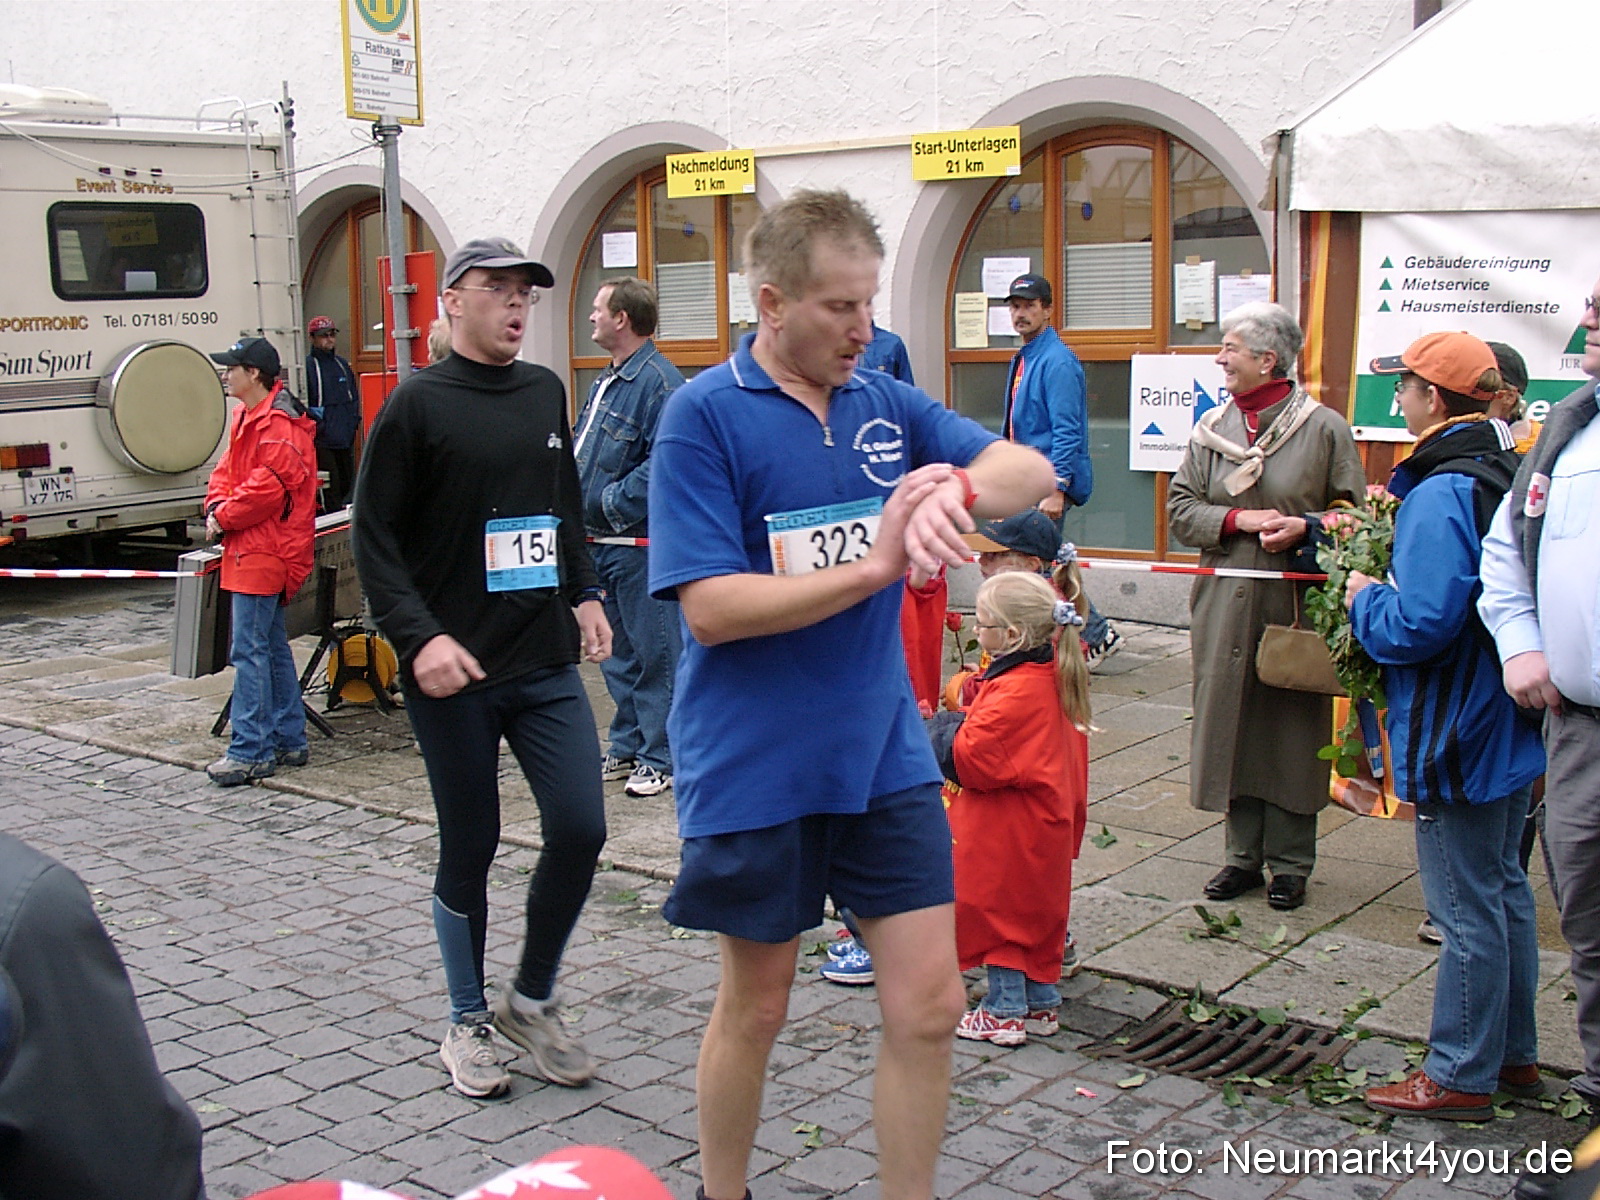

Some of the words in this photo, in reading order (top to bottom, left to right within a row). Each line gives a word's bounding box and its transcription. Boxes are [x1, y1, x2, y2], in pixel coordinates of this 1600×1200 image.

[365, 41, 401, 57] Rathaus
[914, 136, 1017, 155] Start-Unterlagen
[671, 156, 749, 175] Nachmeldung
[945, 159, 960, 173] 21
[965, 158, 984, 172] km
[76, 178, 117, 193] Event
[122, 179, 174, 194] Service
[694, 178, 706, 191] 21
[710, 177, 725, 190] km
[1404, 255, 1551, 272] Gebäudereinigung
[1402, 277, 1490, 291] Mietservice
[1400, 299, 1560, 314] Hausmeisterdienste
[0, 314, 89, 332] PORTRONIC
[103, 314, 126, 328] Tel.
[0, 351, 33, 377] Sun
[36, 349, 92, 378] Sport
[1139, 386, 1204, 407] Rainer
[39, 477, 61, 491] WN
[54, 489, 74, 503] 175
[512, 531, 555, 565] 154
[809, 521, 872, 569] 323
